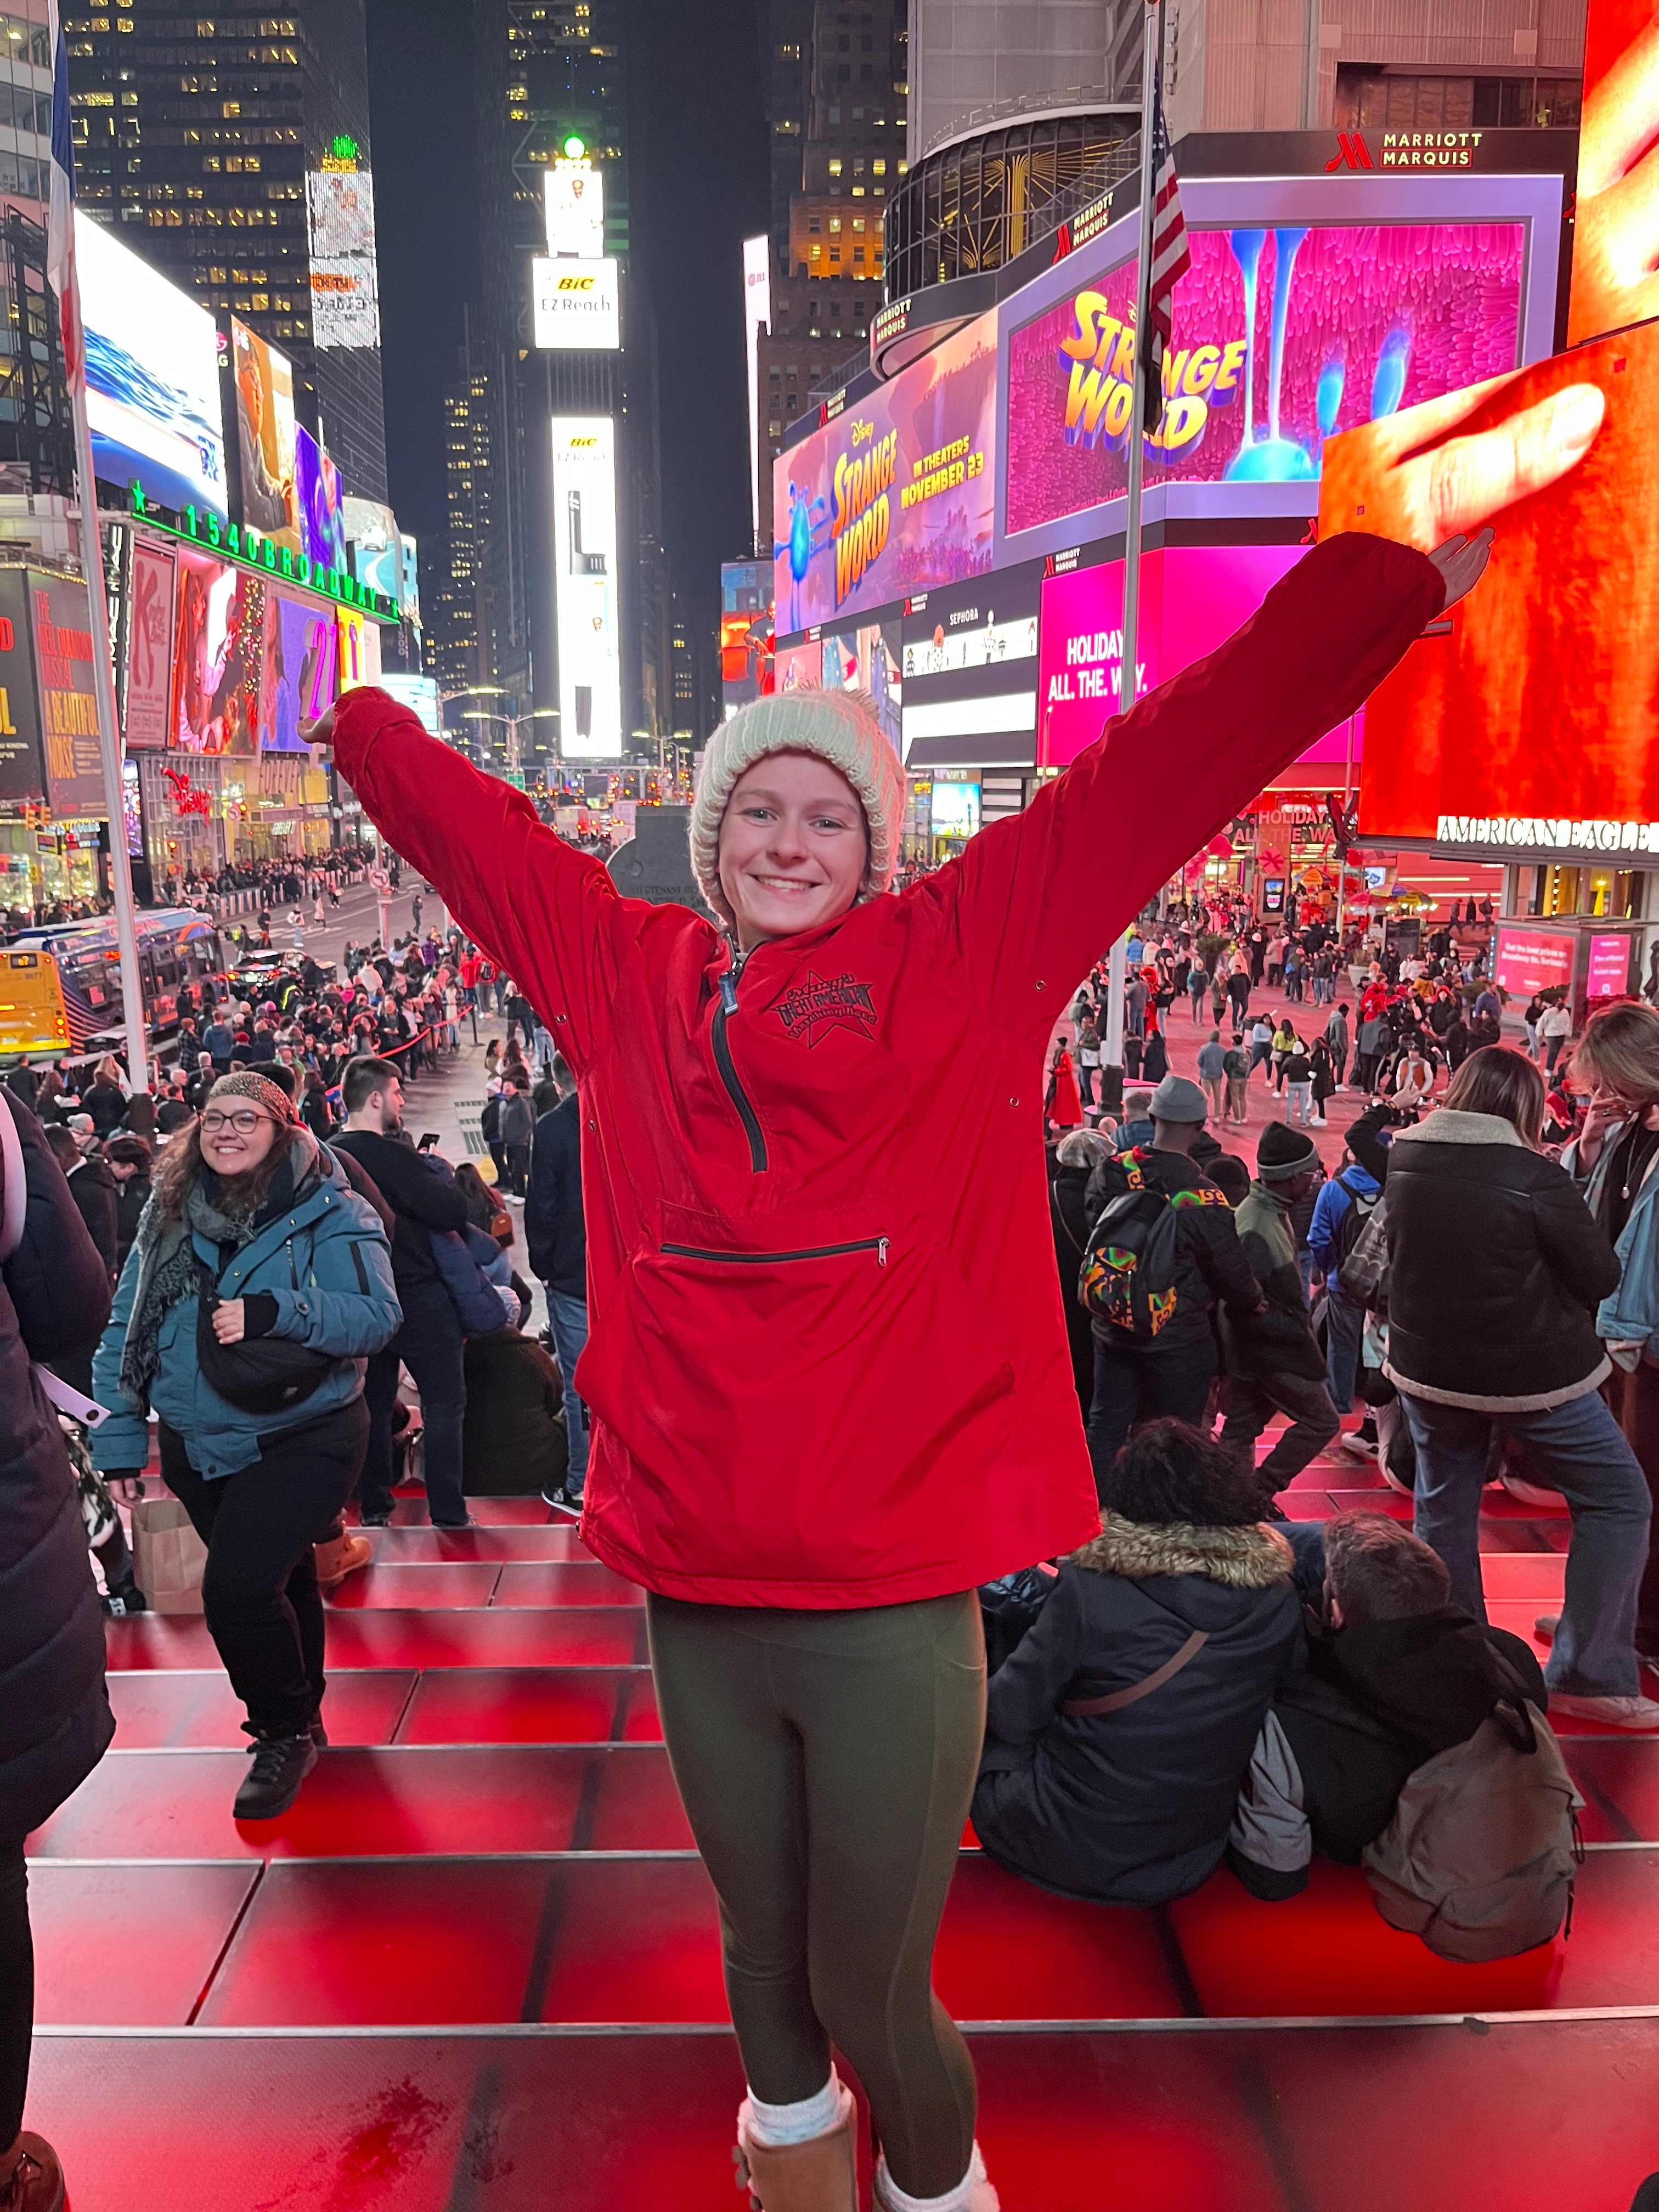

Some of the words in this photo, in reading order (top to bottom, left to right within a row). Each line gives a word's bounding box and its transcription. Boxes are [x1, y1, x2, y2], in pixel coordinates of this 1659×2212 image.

[1384, 133, 1482, 146] MARRIOTT
[1383, 151, 1469, 165] MARQUIS
[1074, 192, 1114, 230] MARRIOTT
[1073, 212, 1108, 246] MARQUIS
[542, 298, 558, 311] EZ
[563, 294, 610, 311] Reach
[876, 298, 912, 329] MARRIOTT
[876, 317, 906, 344] MARQUIS
[1059, 291, 1248, 397] STRNGE
[1064, 359, 1208, 450] WOD
[850, 419, 874, 448] Disney
[913, 460, 923, 479] IN
[923, 435, 970, 472] THEATERS
[832, 428, 898, 539] STRANGE
[900, 461, 964, 510] NOVEMBER
[967, 451, 984, 481] 23
[836, 493, 890, 605] WORLD
[1055, 548, 1081, 562] MARRIOTT
[1055, 558, 1077, 572] MARQUIS
[264, 537, 378, 611] BROADWAY
[949, 607, 979, 626] SEPHORA
[1067, 629, 1124, 665] HOLIDAY
[1048, 674, 1075, 702] ALL.
[1077, 668, 1108, 699] THE.
[1110, 662, 1148, 696] WY.
[1259, 809, 1326, 825] HOLIDAY
[1436, 815, 1571, 848] AMERICAN
[1570, 820, 1650, 851] EAGLE
[1310, 827, 1337, 842] WA
